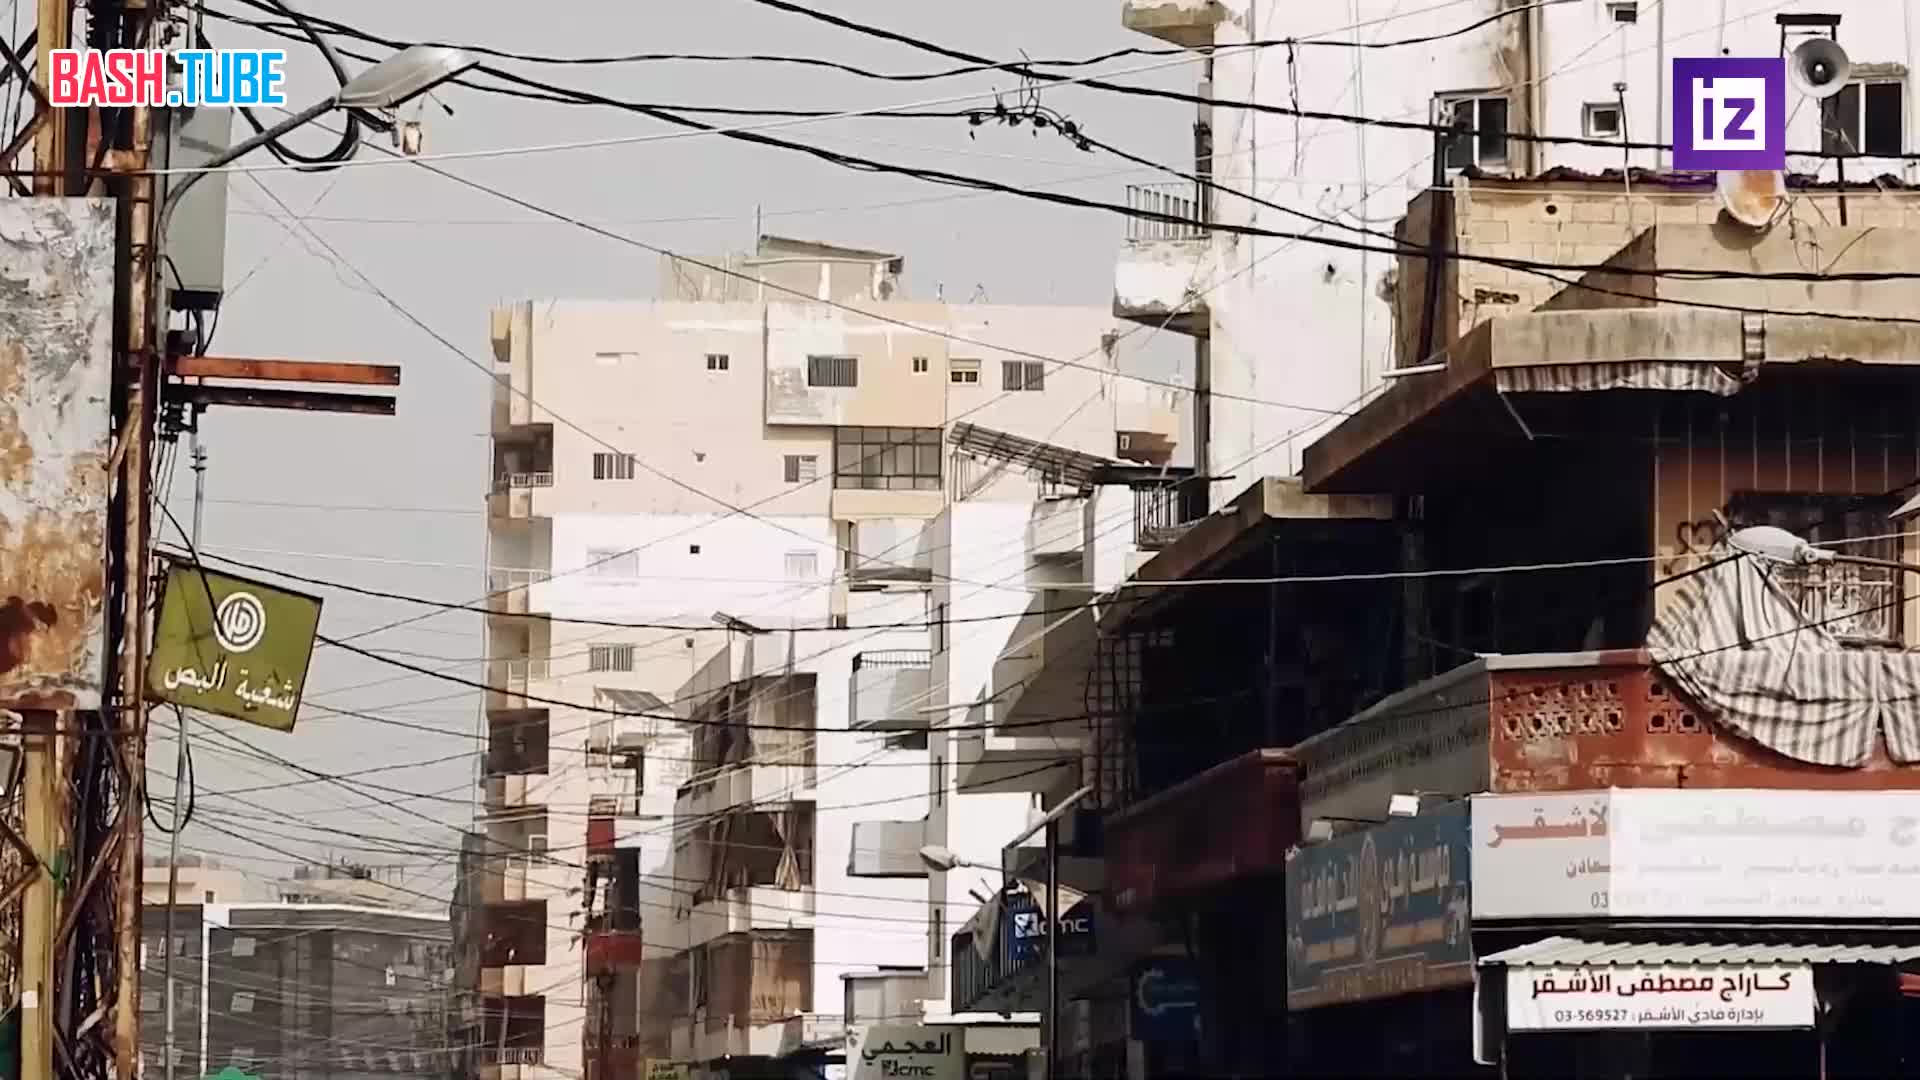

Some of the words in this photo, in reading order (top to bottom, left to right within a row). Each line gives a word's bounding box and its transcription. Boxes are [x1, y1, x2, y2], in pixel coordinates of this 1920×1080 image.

[164, 660, 228, 694] البص
[1720, 971, 1792, 1002] كاراج
[1554, 1009, 1628, 1022] 03-569527
[862, 1031, 951, 1067] العجمي
